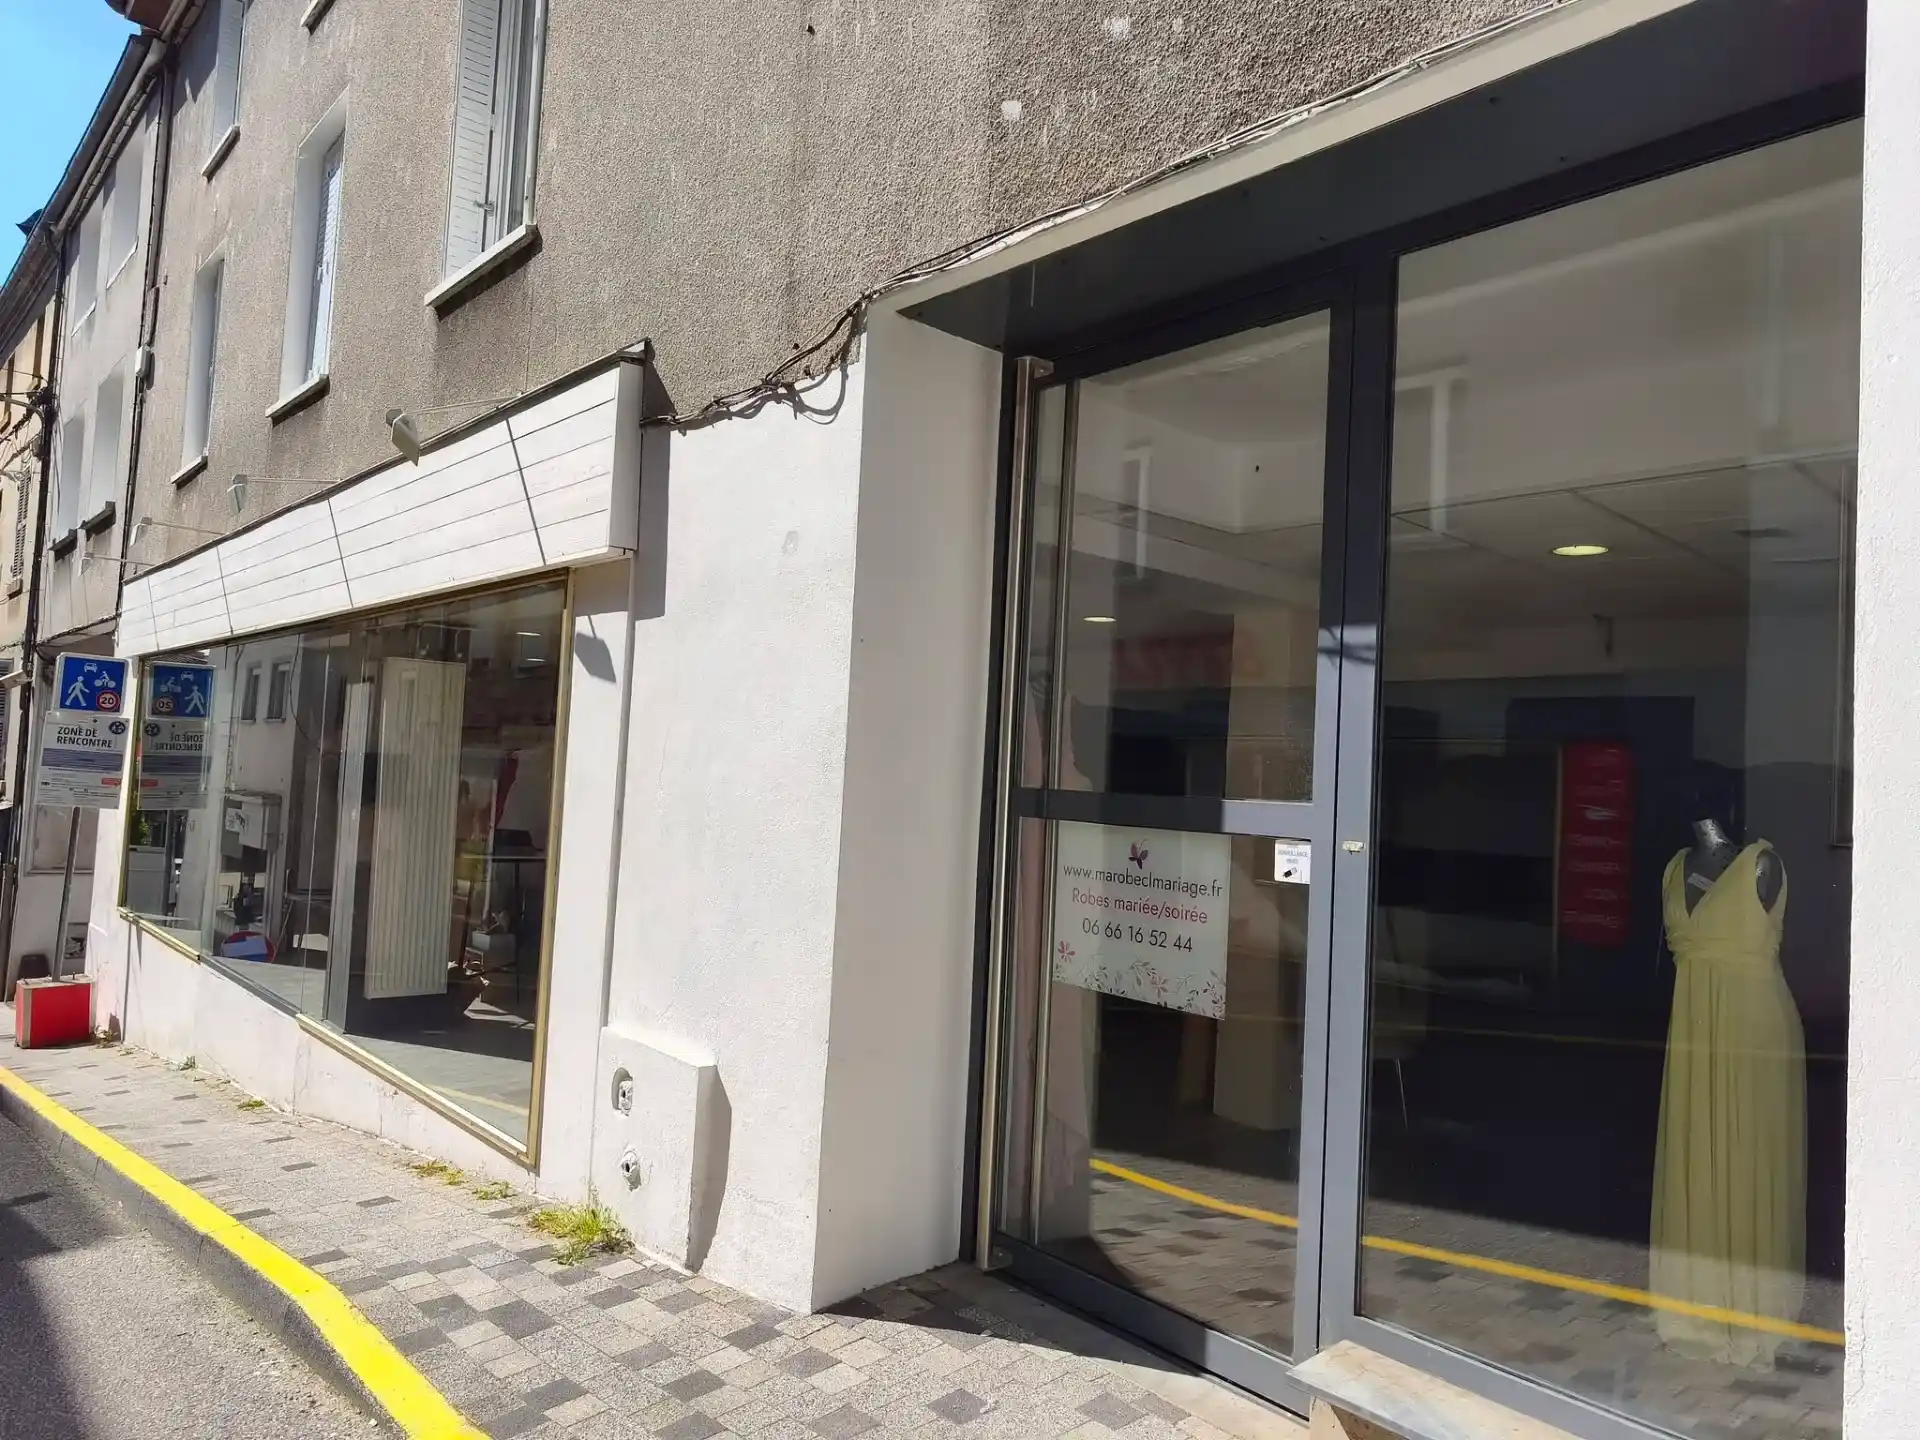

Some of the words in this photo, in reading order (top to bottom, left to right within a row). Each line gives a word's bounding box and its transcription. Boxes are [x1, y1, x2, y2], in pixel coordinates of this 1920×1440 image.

[101, 696, 115, 706] 20
[56, 735, 113, 748] RENCONTRE
[57, 726, 84, 737] ZONE
[85, 728, 98, 738] DE
[1063, 865, 1223, 898] www.marobeclmariage.fr
[1072, 887, 1110, 908] Robes
[1114, 898, 1208, 924] mariée/soirée
[1082, 917, 1100, 936] 06
[1104, 922, 1122, 940] 66
[1128, 925, 1144, 944] 16
[1149, 929, 1168, 949] 52
[1173, 933, 1193, 953] 44
